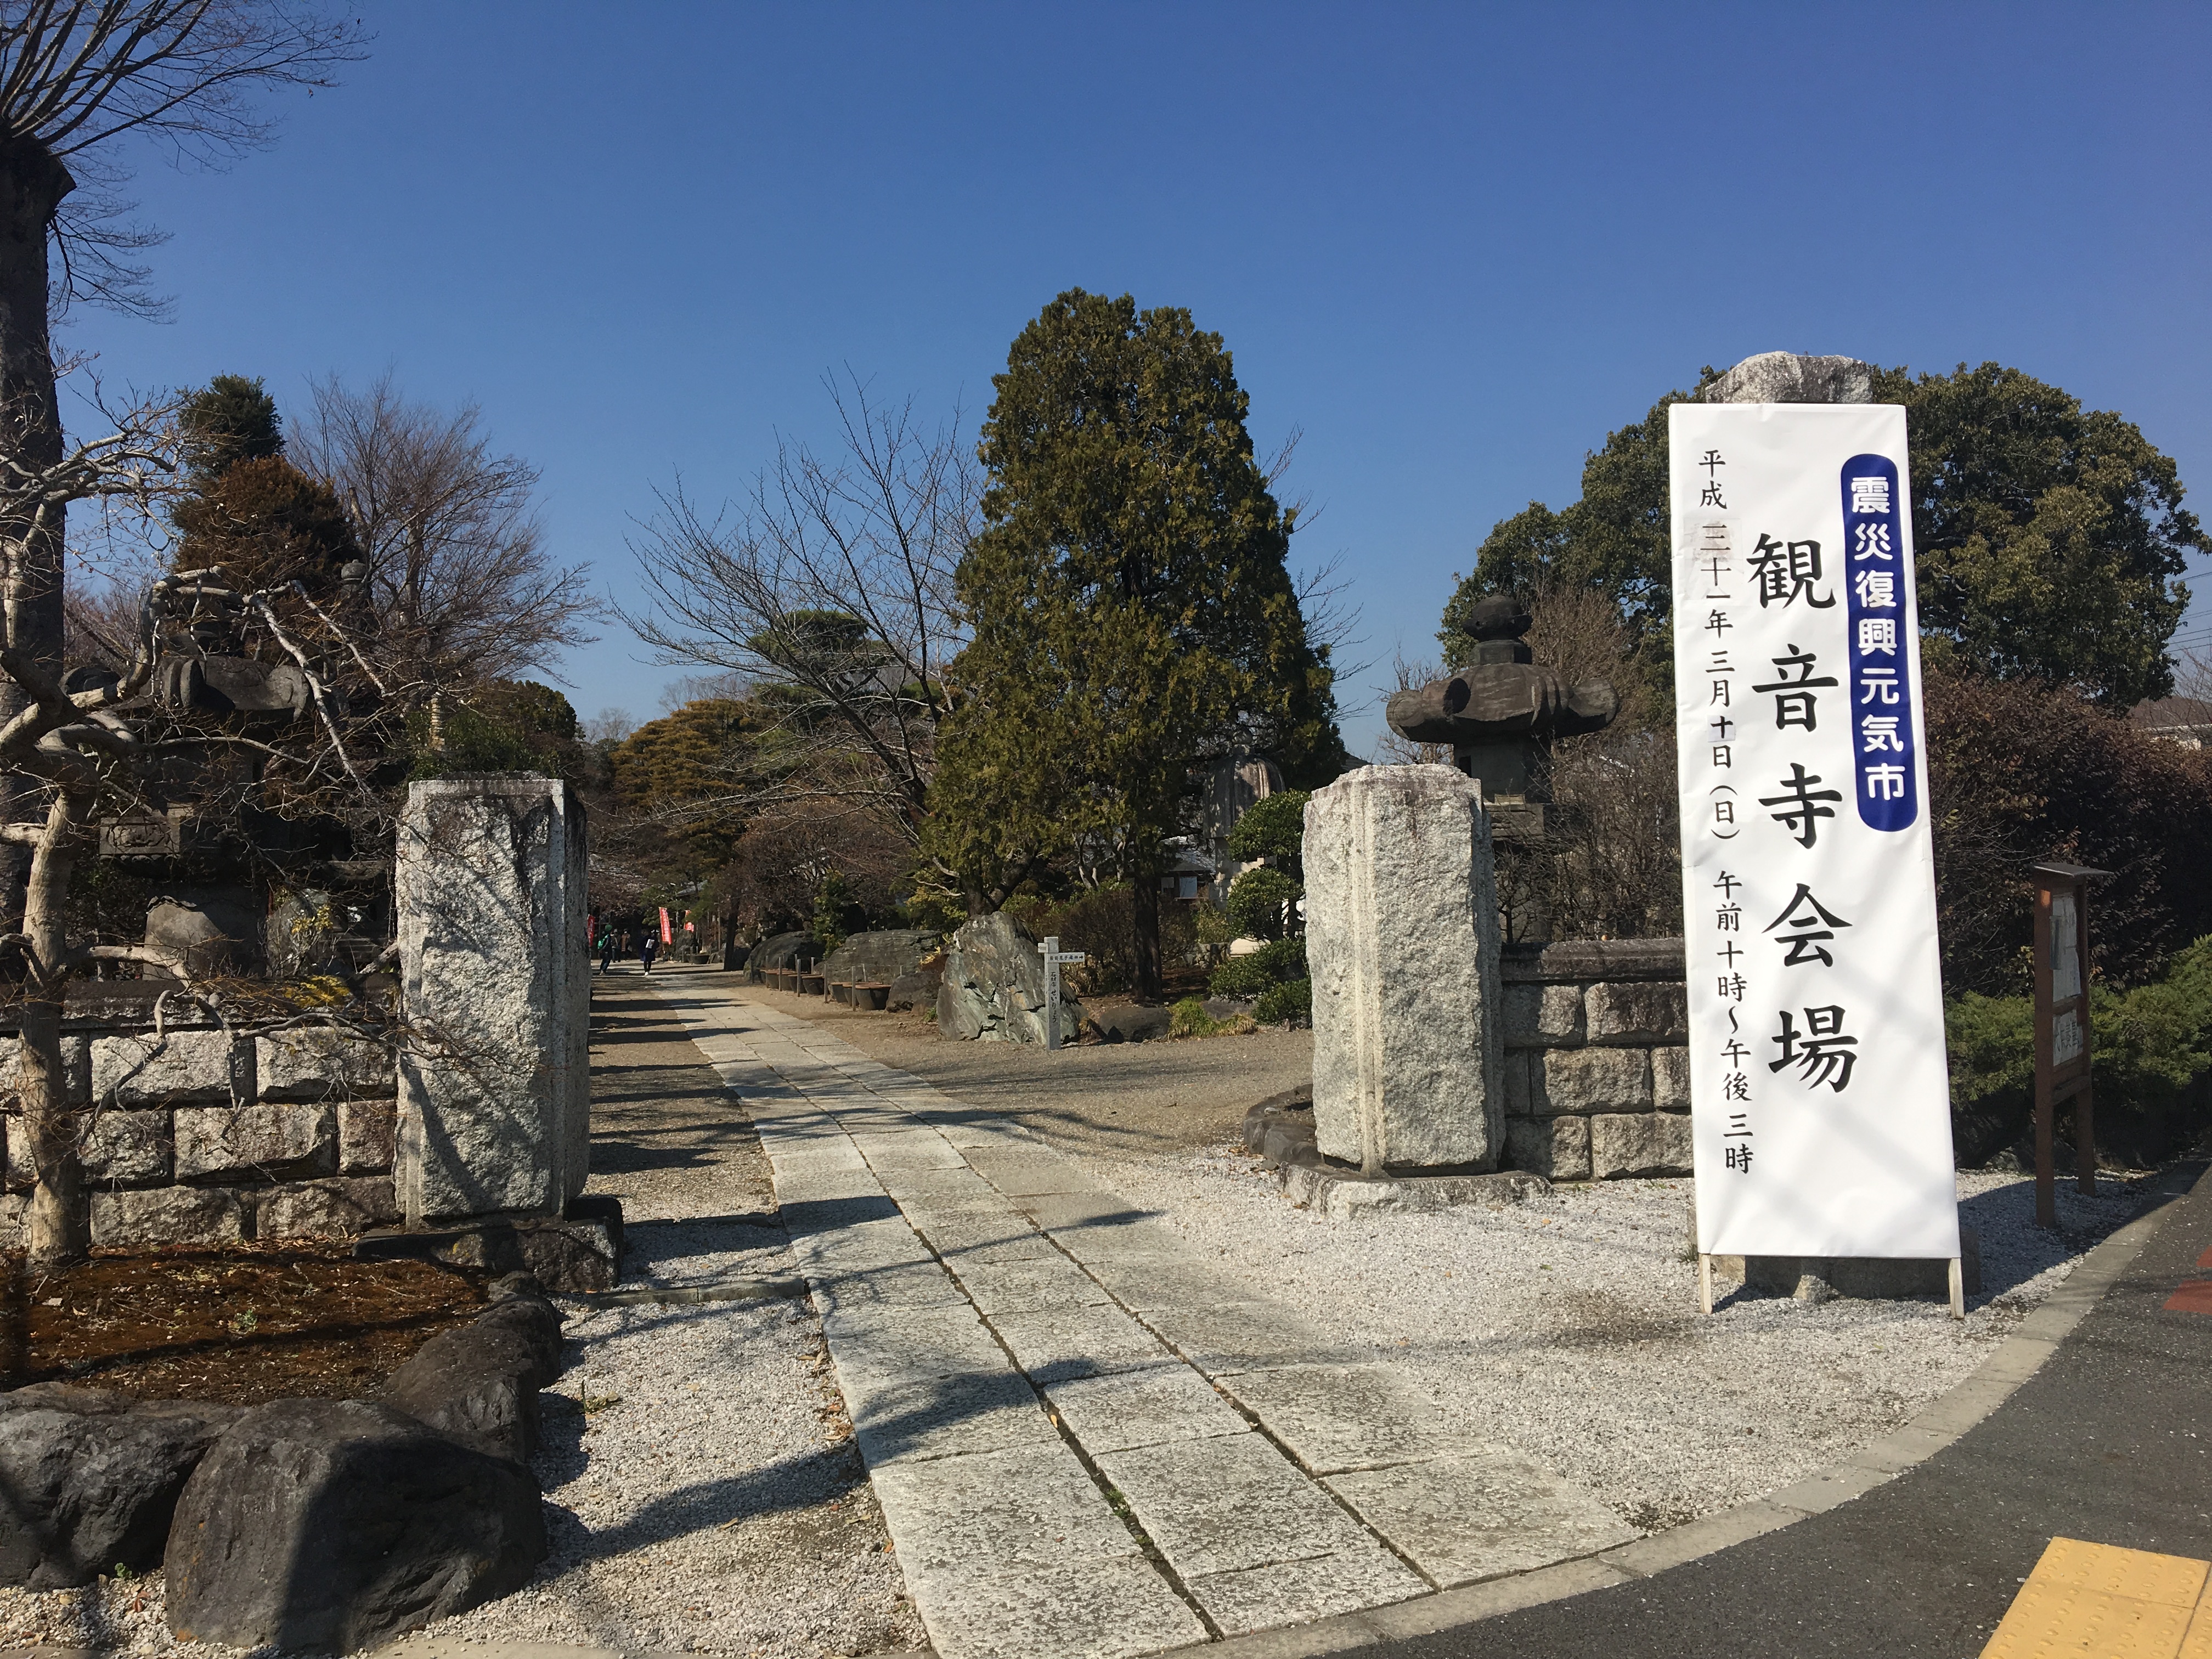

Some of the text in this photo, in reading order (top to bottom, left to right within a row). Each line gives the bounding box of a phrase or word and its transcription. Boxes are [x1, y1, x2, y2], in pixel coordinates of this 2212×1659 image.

[1746, 533, 1859, 1093] 観音寺会場
[1850, 476, 1906, 802] 震災復興元気市
